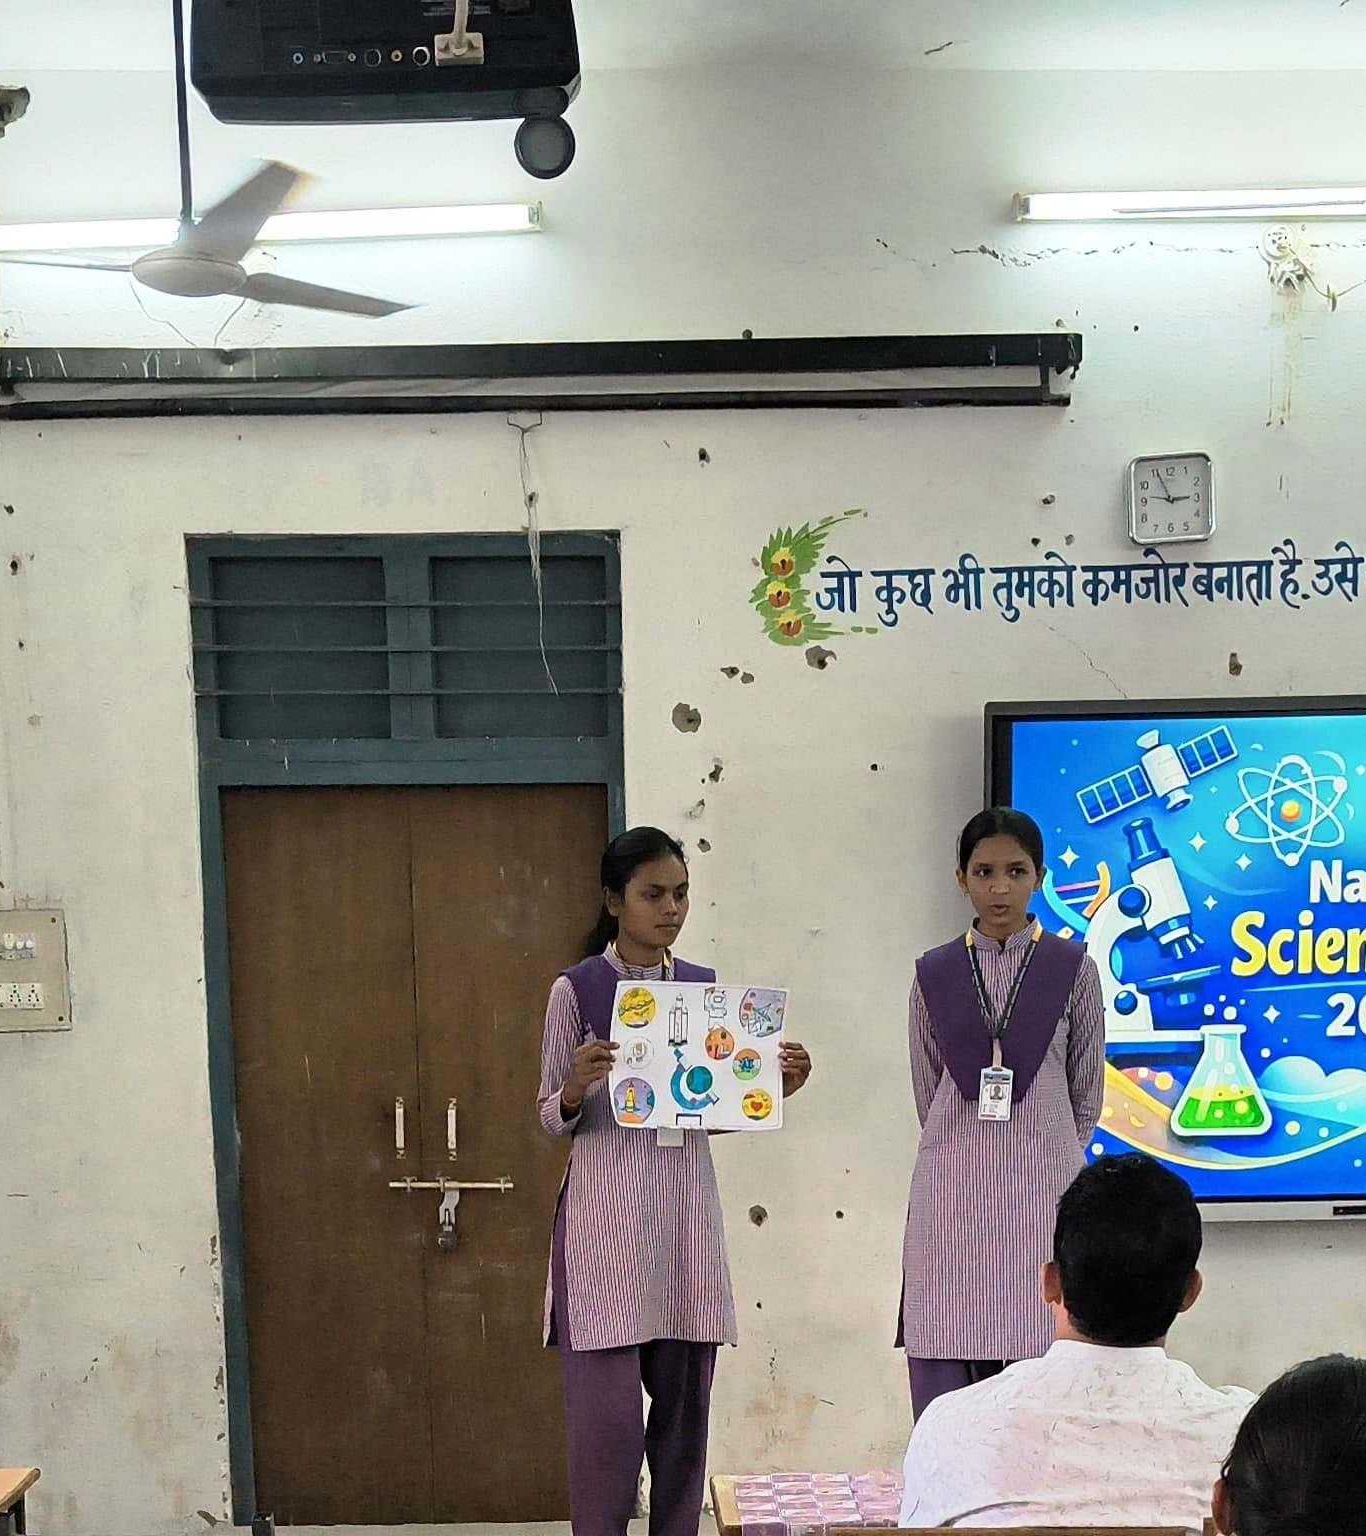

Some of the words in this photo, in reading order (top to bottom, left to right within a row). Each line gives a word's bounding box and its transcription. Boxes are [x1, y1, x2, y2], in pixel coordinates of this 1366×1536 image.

[1165, 466, 1176, 477] 12
[1139, 481, 1150, 491] 10
[815, 555, 863, 613] जो
[942, 553, 985, 611] भी
[989, 551, 1077, 623] तुमको
[1081, 548, 1190, 608] कमजोर
[1192, 559, 1274, 607] बनाता
[1311, 541, 1365, 602] उसे
